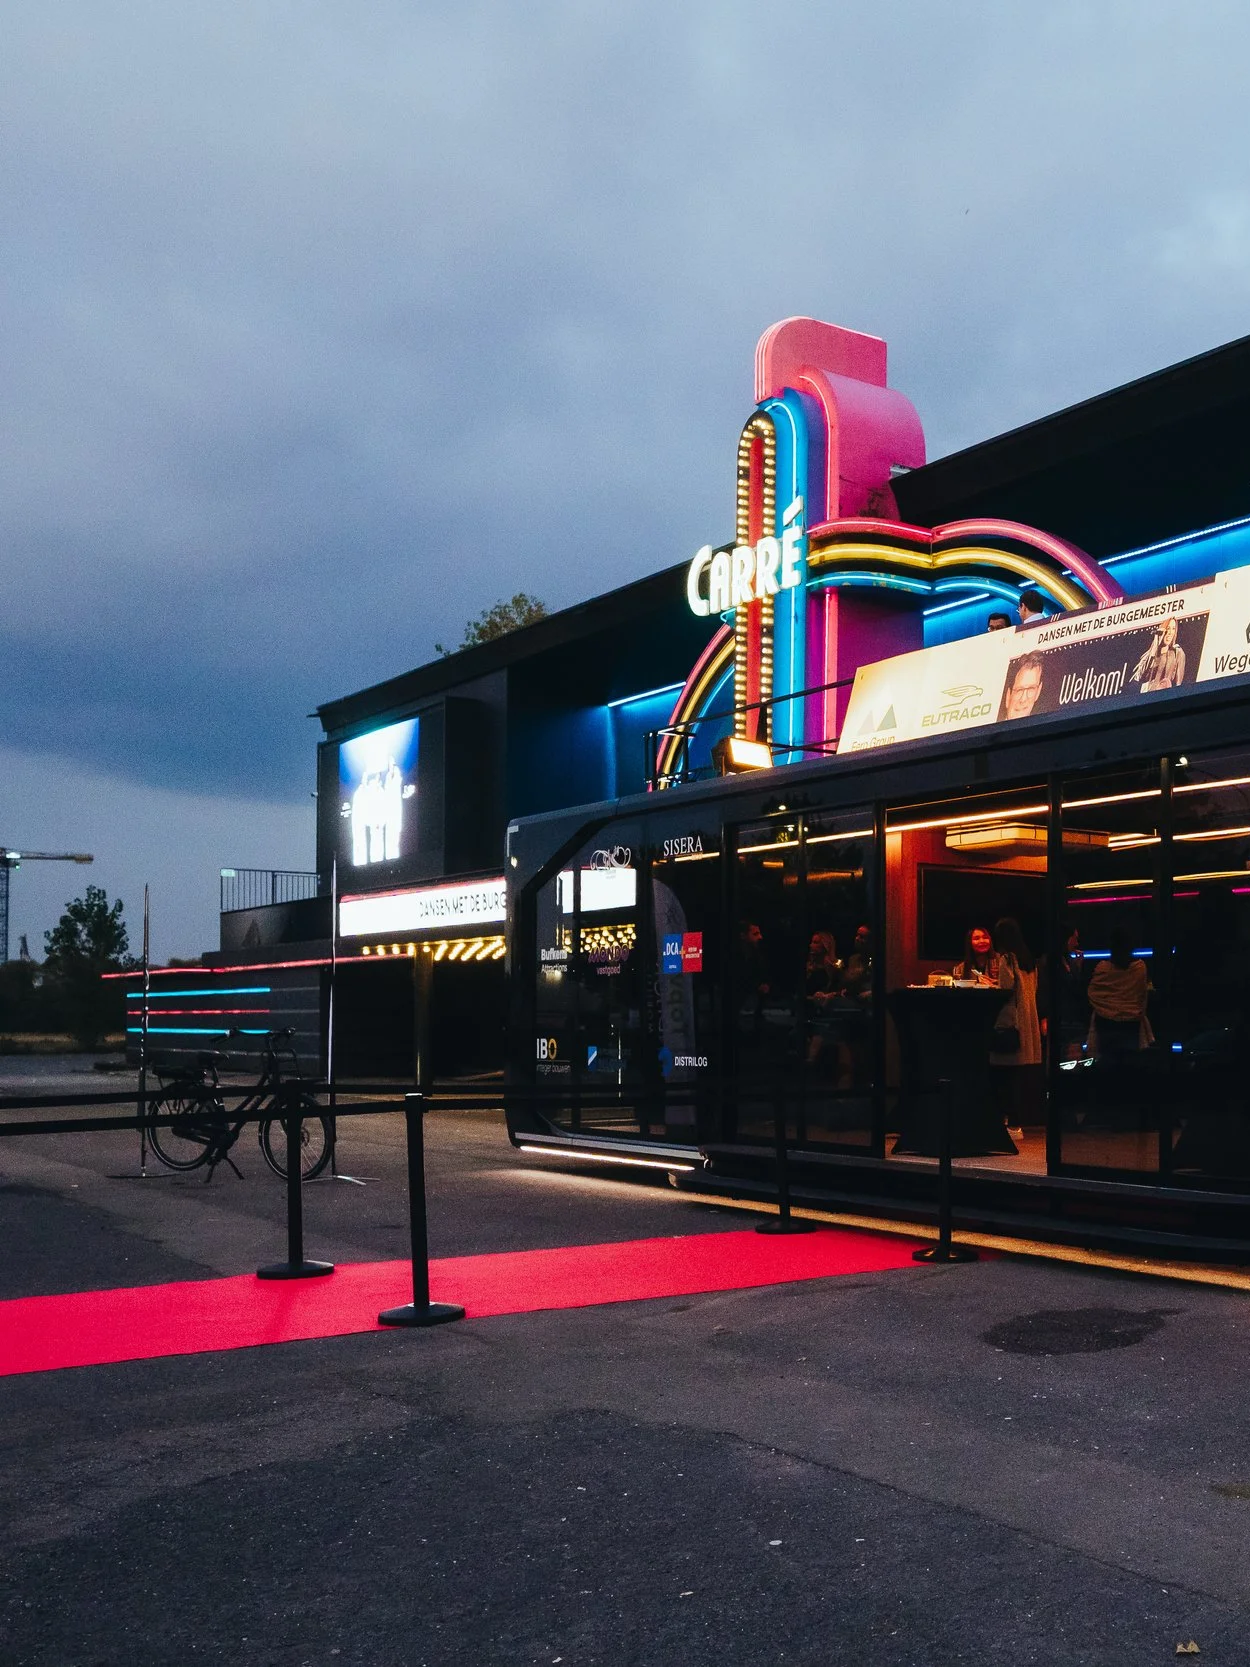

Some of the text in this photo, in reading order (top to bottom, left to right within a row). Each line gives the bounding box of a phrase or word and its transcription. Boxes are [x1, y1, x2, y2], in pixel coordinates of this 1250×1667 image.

[687, 495, 804, 617] CARRÉ
[1037, 599, 1186, 645] DANSEN MET DE BURGEMEESTER
[1058, 662, 1128, 706] Welkom!
[921, 702, 993, 728] EUTRACO
[663, 835, 703, 857] SISERA
[536, 1037, 558, 1060] IBO
[674, 1056, 708, 1067] DISTRILOG
